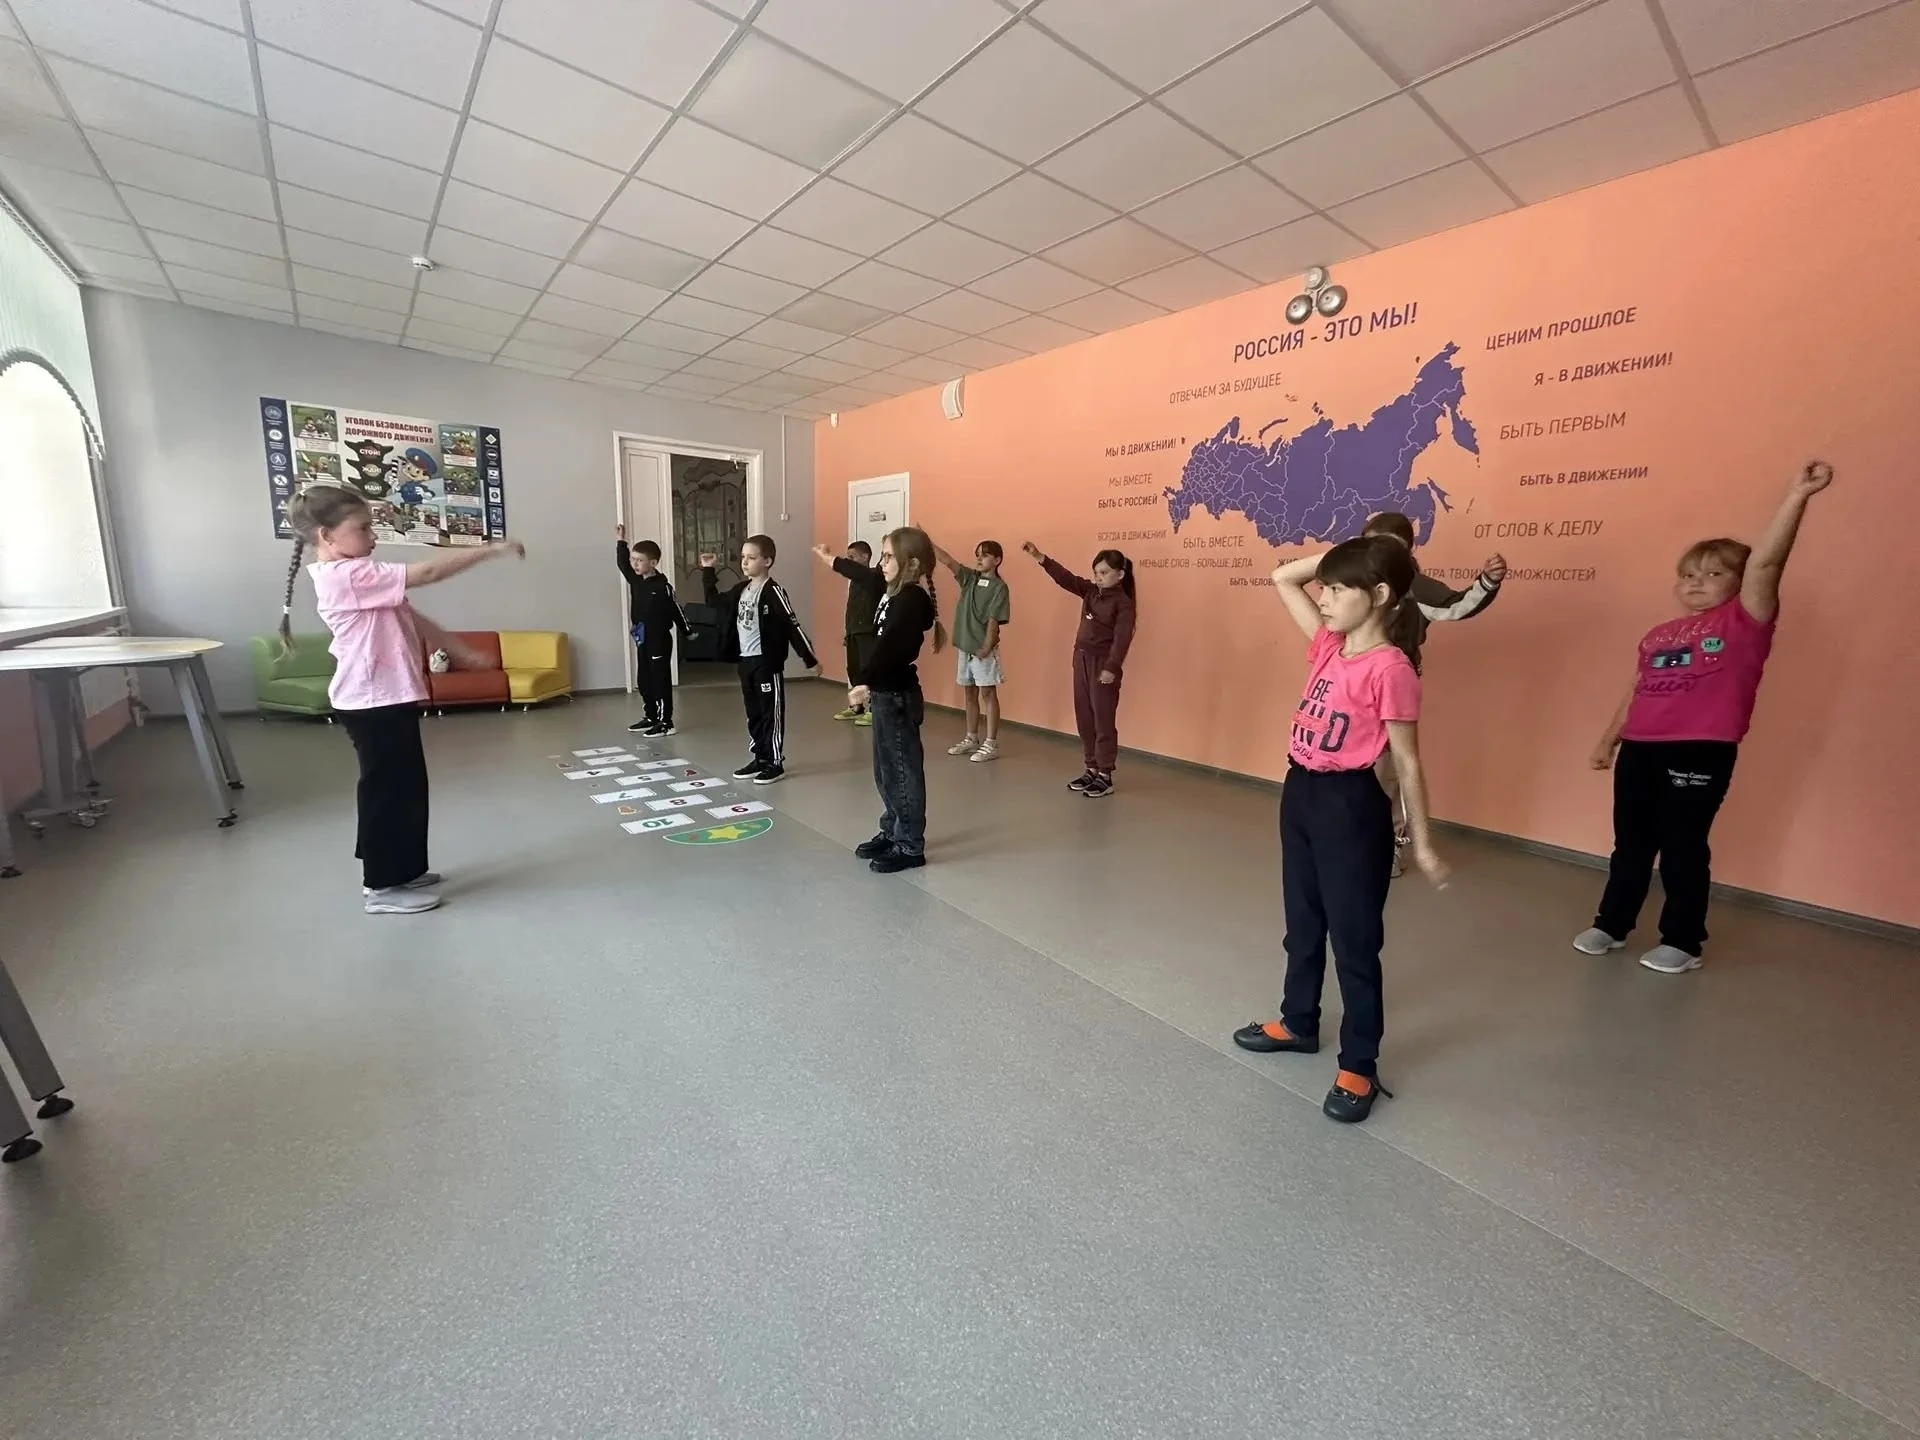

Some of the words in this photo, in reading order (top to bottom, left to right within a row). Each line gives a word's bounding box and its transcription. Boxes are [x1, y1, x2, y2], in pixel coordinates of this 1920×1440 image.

[1234, 328, 1305, 364] РОССИЯ
[1324, 316, 1363, 343] ЭТО
[1369, 301, 1418, 333] МЫ!
[1486, 326, 1543, 351] ЦЕНИМ
[1547, 306, 1638, 339] ПРОШЛОЕ
[1534, 372, 1544, 386] Я
[1559, 369, 1568, 382] В
[1571, 351, 1673, 382] ДВИЖЕНИИ!
[1169, 384, 1217, 404] ОТВЕЧАЕМ
[1219, 382, 1231, 395] ЗА
[1234, 372, 1282, 392] БУДУЩЕЕ
[344, 415, 375, 428] УГОЛОК
[375, 420, 433, 434] БЕЗОПАСНОСТИ
[1499, 421, 1544, 440] БЫТЬ
[1549, 411, 1627, 435] ПЕРВЫМ
[345, 427, 393, 440] ДОРОЖНОГО
[393, 432, 434, 444] ДВИЖЕНИЯ
[359, 447, 381, 456] СТОЙ!
[1105, 446, 1119, 458] МЫ
[1120, 445, 1126, 456] В
[1127, 437, 1177, 456] ДВИЖЕНИИ!
[1108, 477, 1122, 488] МЫ
[1123, 473, 1153, 487] ВМЕСТЕ
[1519, 473, 1554, 487] БЫТЬ
[1556, 472, 1566, 484] В
[1568, 466, 1649, 485] ДВИЖЕНИИ
[1098, 497, 1117, 509] БЫТЬ
[1117, 497, 1123, 508] С
[1124, 493, 1158, 508] РОССИЕЙ
[1121, 531, 1127, 541] В
[1474, 523, 1493, 539] ОТ
[1496, 522, 1539, 538] СЛОВ
[1543, 521, 1555, 536] К
[1557, 519, 1604, 539] ДЕЛУ
[1183, 537, 1207, 549] БЫТЬ
[1208, 536, 1245, 548] ВМЕСТЕ
[1139, 558, 1169, 569] МЕНЬШЕ
[1170, 558, 1190, 568] СЛОВ
[1197, 558, 1229, 569] БОЛЬШЕ
[1231, 557, 1253, 569] ДЕЛА
[1229, 577, 1249, 587] БЫТЬ
[1504, 564, 1597, 582] ЗМОЖНОСТЕЙ
[1309, 678, 1334, 704] BE
[641, 818, 675, 829] 10
